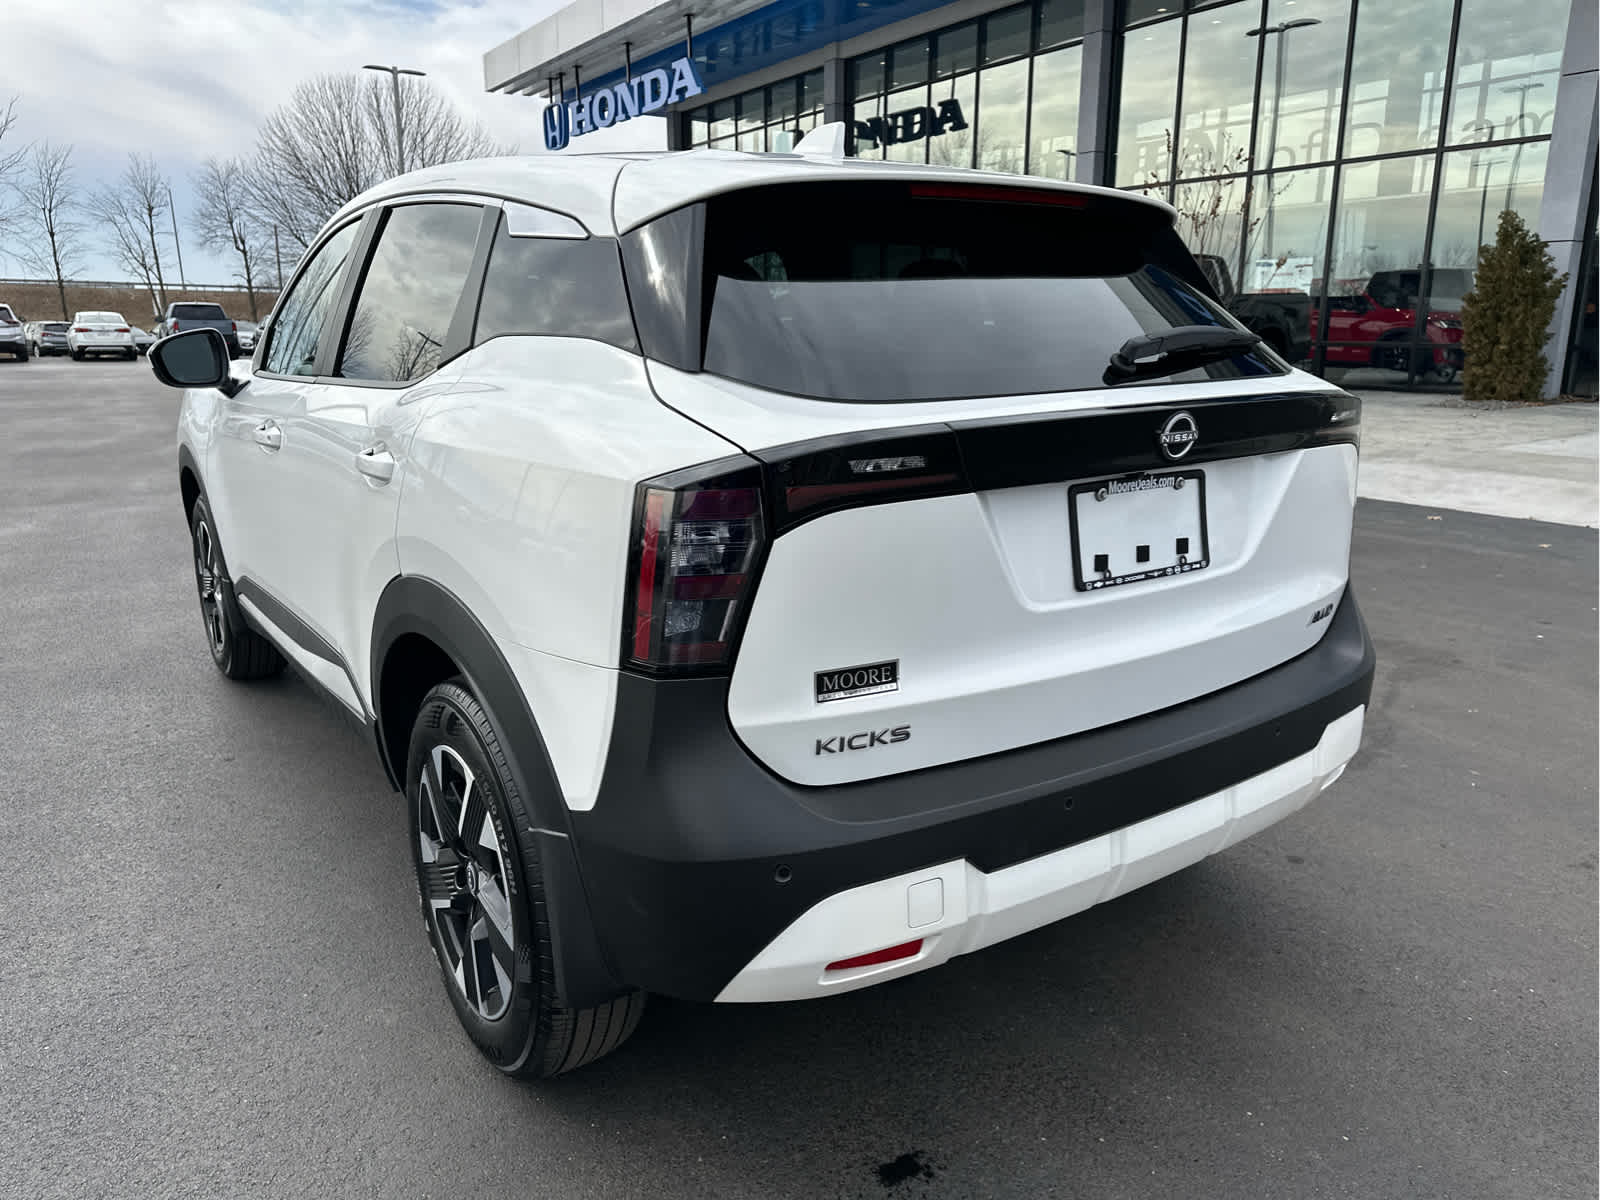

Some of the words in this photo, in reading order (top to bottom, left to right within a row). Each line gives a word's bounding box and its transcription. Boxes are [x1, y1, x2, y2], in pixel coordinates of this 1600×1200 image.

[569, 56, 704, 137] HONDA
[1161, 431, 1198, 443] NISSAN
[1108, 475, 1175, 495] MooreDeals.com
[822, 666, 893, 692] MOORE
[815, 725, 911, 756] KICKS
